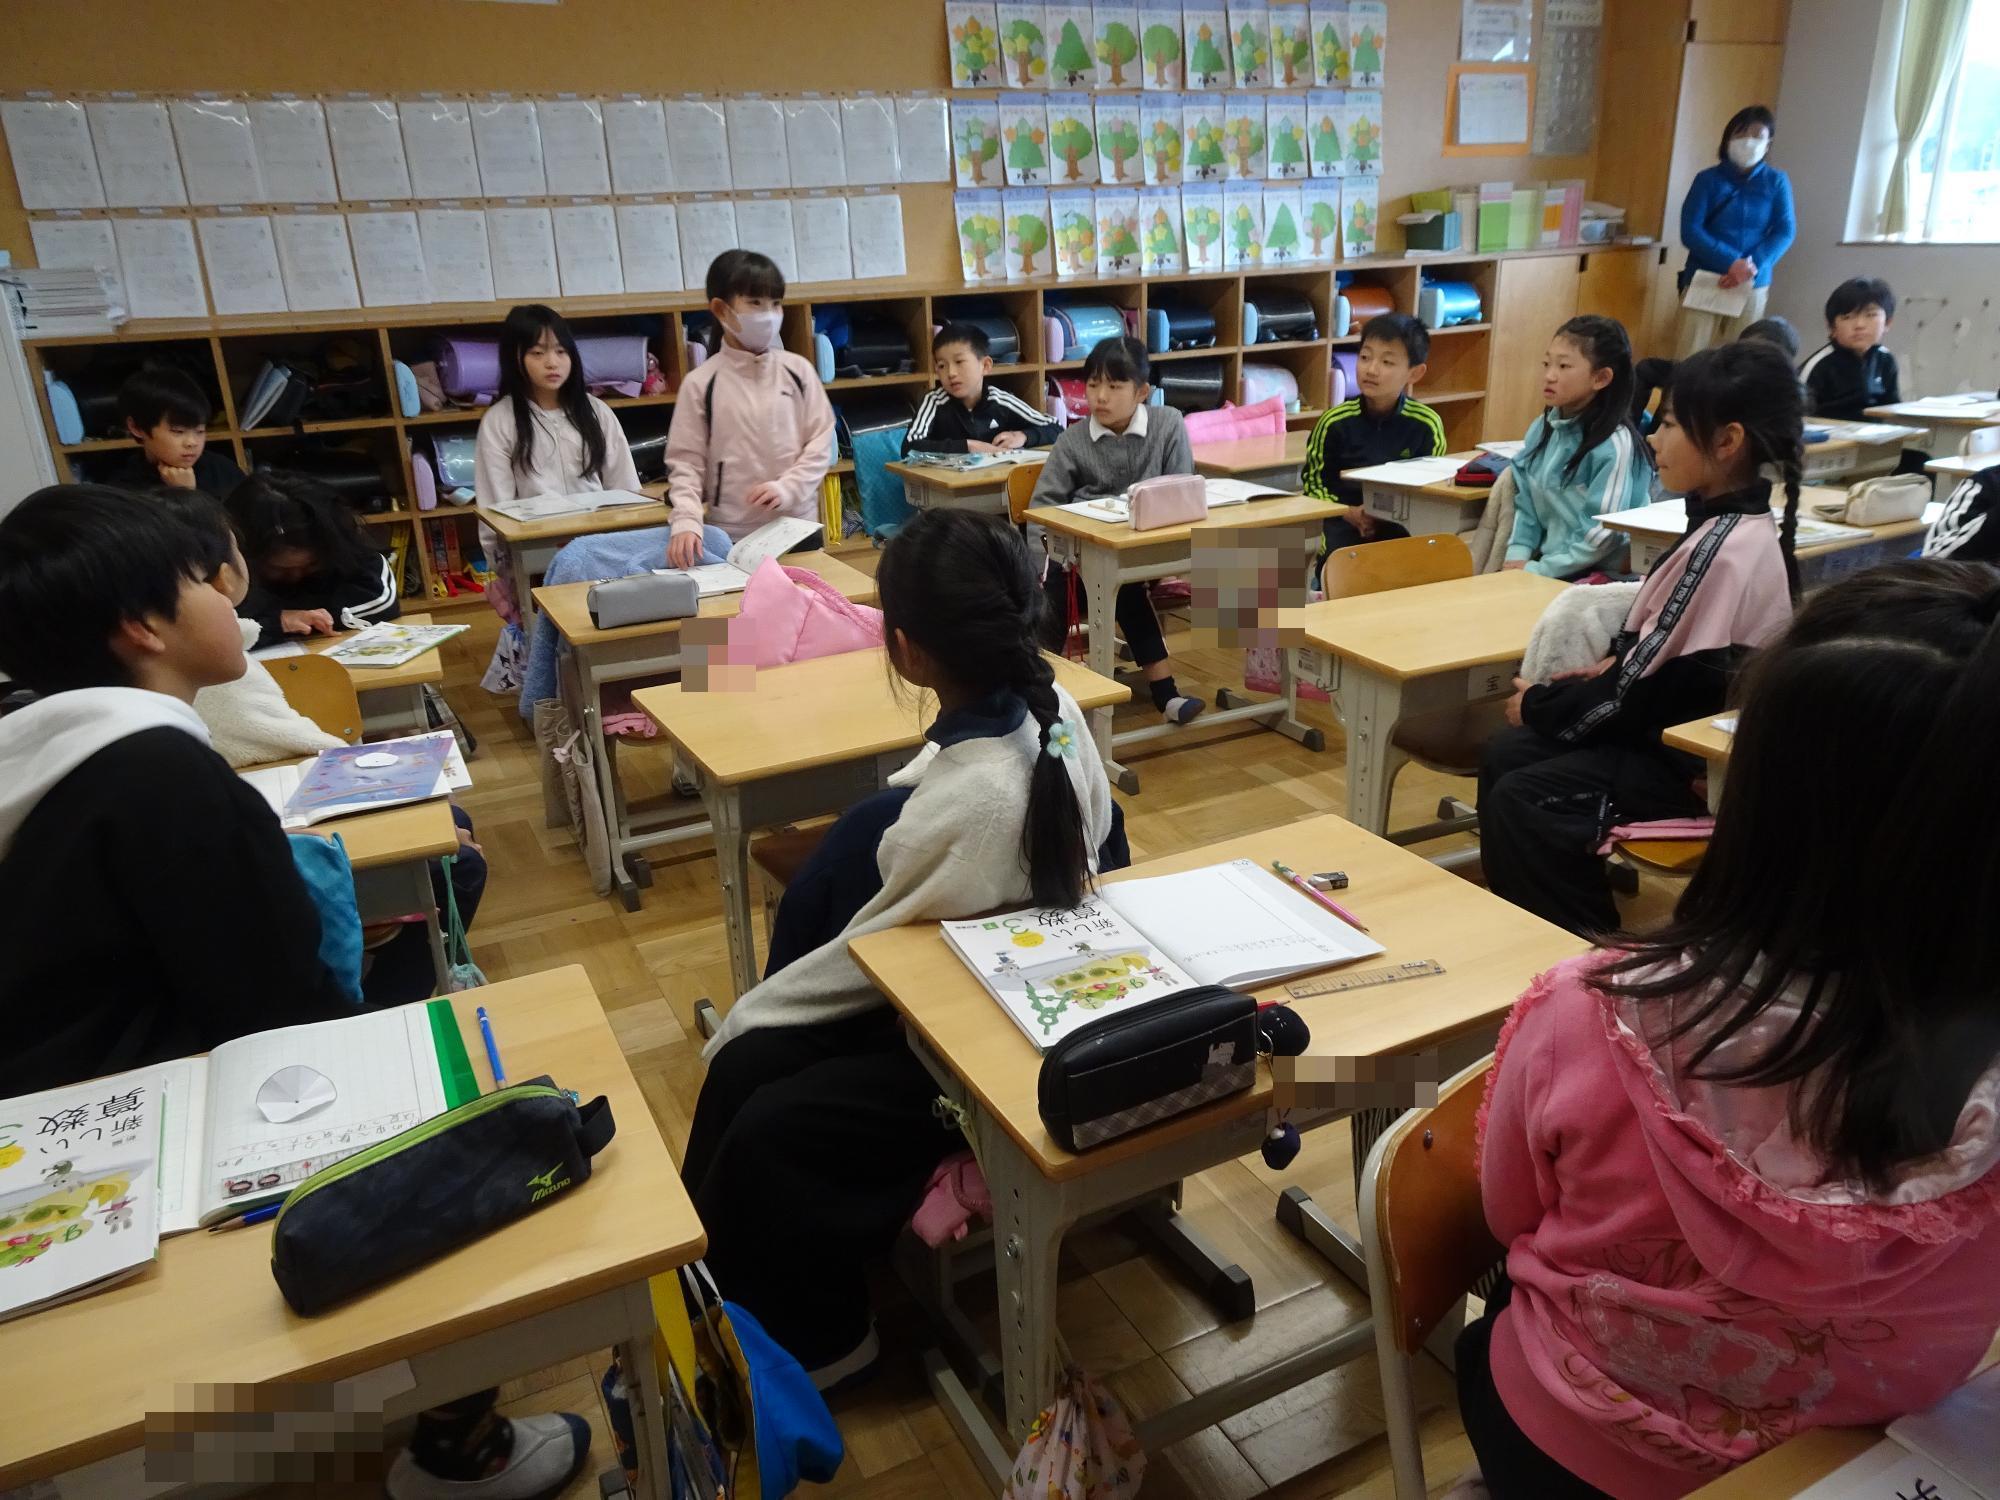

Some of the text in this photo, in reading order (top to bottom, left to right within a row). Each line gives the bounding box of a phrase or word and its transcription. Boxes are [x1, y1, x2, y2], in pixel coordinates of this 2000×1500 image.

[1051, 917, 1116, 938] 新しい
[36, 1086, 146, 1136] 算数
[39, 1114, 144, 1154] 新しい
